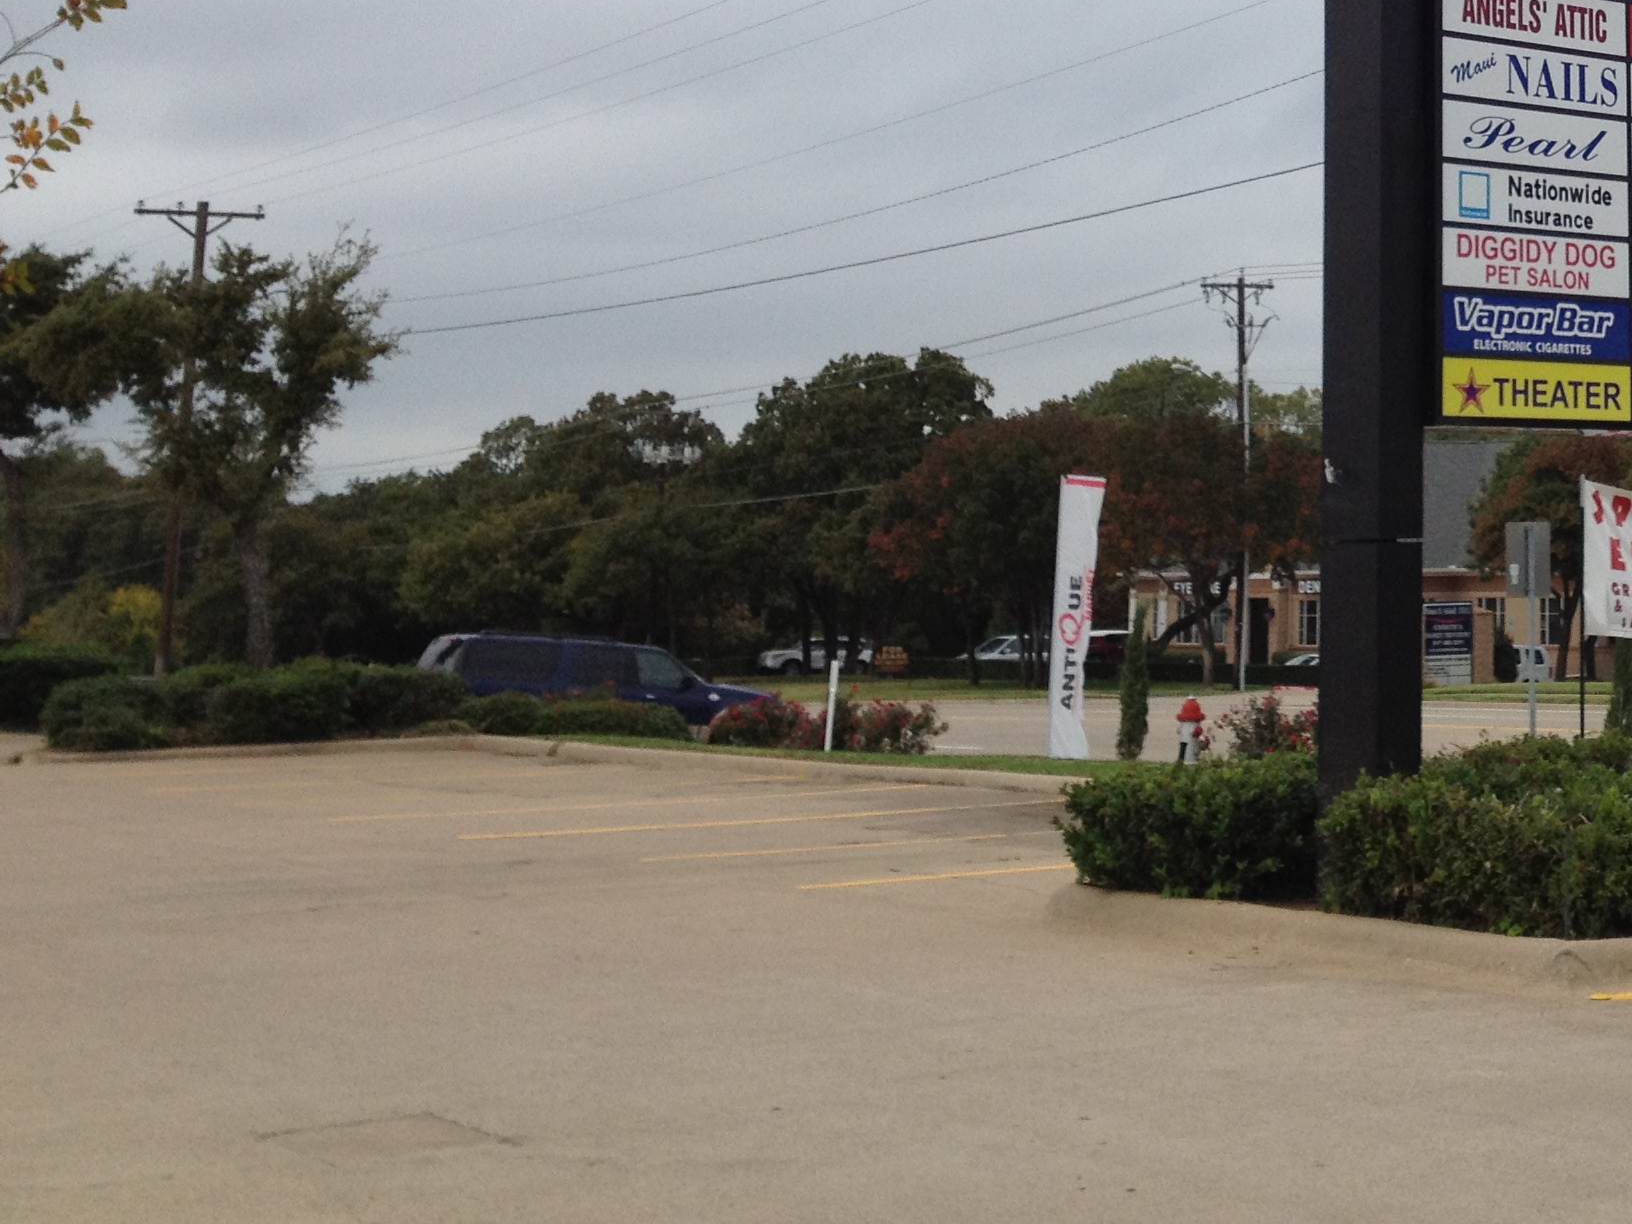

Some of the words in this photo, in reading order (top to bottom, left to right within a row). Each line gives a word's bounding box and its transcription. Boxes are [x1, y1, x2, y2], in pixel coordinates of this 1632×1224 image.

[1555, 5, 1607, 43] ATTIC
[1451, 53, 1497, 83] Maui
[1506, 54, 1618, 107] NAILS
[1463, 116, 1608, 162] Pearl
[1508, 176, 1612, 206] Nationwide
[1508, 204, 1594, 230] Insurance
[1457, 233, 1556, 265] DIGGIDY
[1565, 242, 1615, 269] DOG
[1485, 265, 1522, 284] PET
[1526, 267, 1590, 290] SALON
[1473, 340, 1531, 353] ELECTRONIC
[1536, 342, 1592, 356] CIGARETTES
[1493, 378, 1621, 410] THEATER
